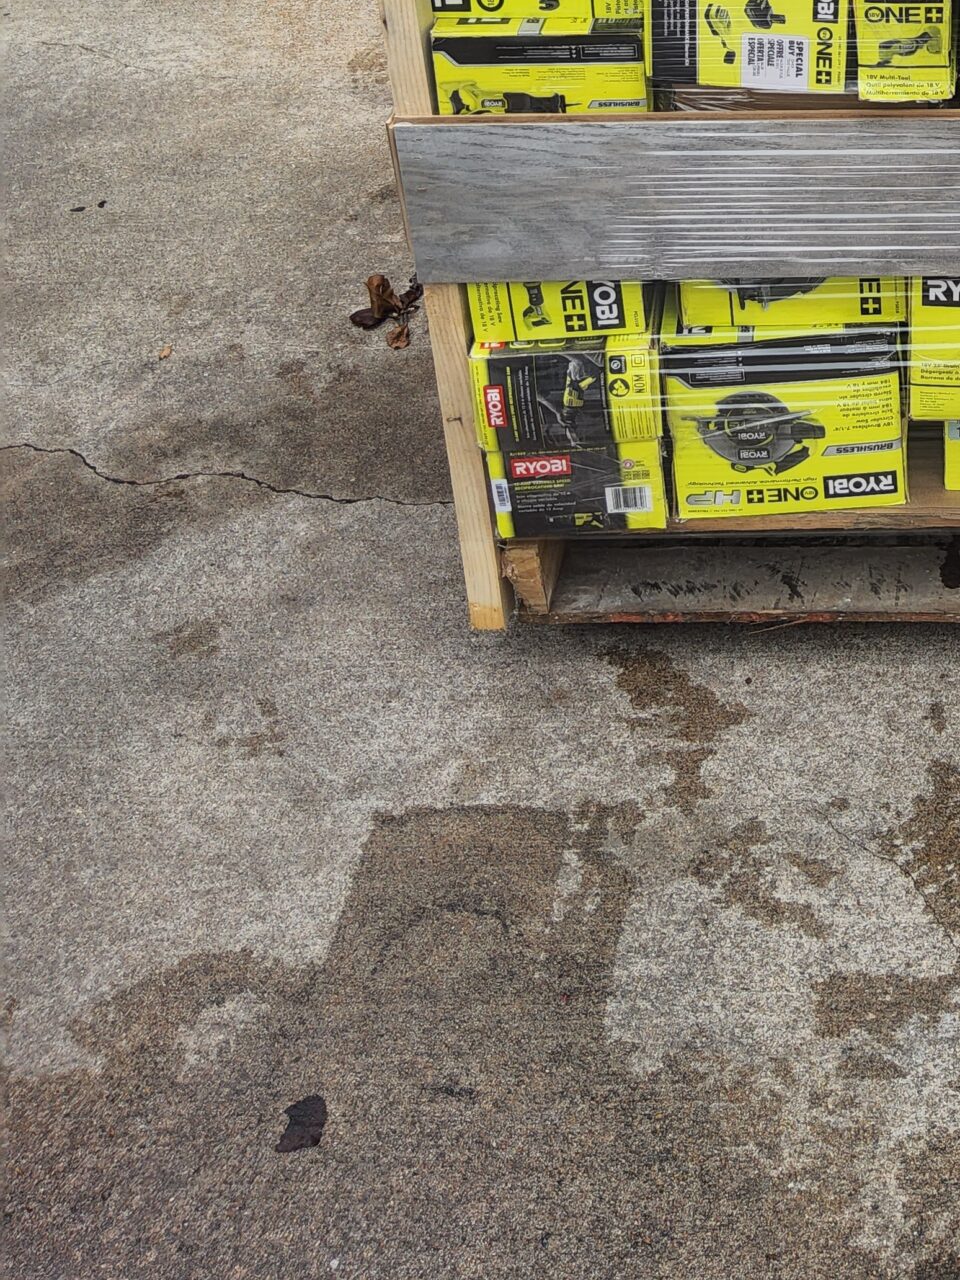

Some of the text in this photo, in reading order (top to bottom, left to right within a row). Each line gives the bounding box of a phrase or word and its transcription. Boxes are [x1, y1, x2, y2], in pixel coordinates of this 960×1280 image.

[865, 7, 943, 24] ONE+
[776, 39, 784, 58] OFFRE
[816, 27, 833, 85] ONE+
[489, 389, 504, 426] RYOBI
[737, 432, 766, 440] RYOBI
[740, 450, 768, 458] RYOBI
[836, 442, 893, 453] BRUSHLESS
[514, 460, 567, 475] RYOBI
[686, 475, 895, 506] RYOBI ONE+ HP
